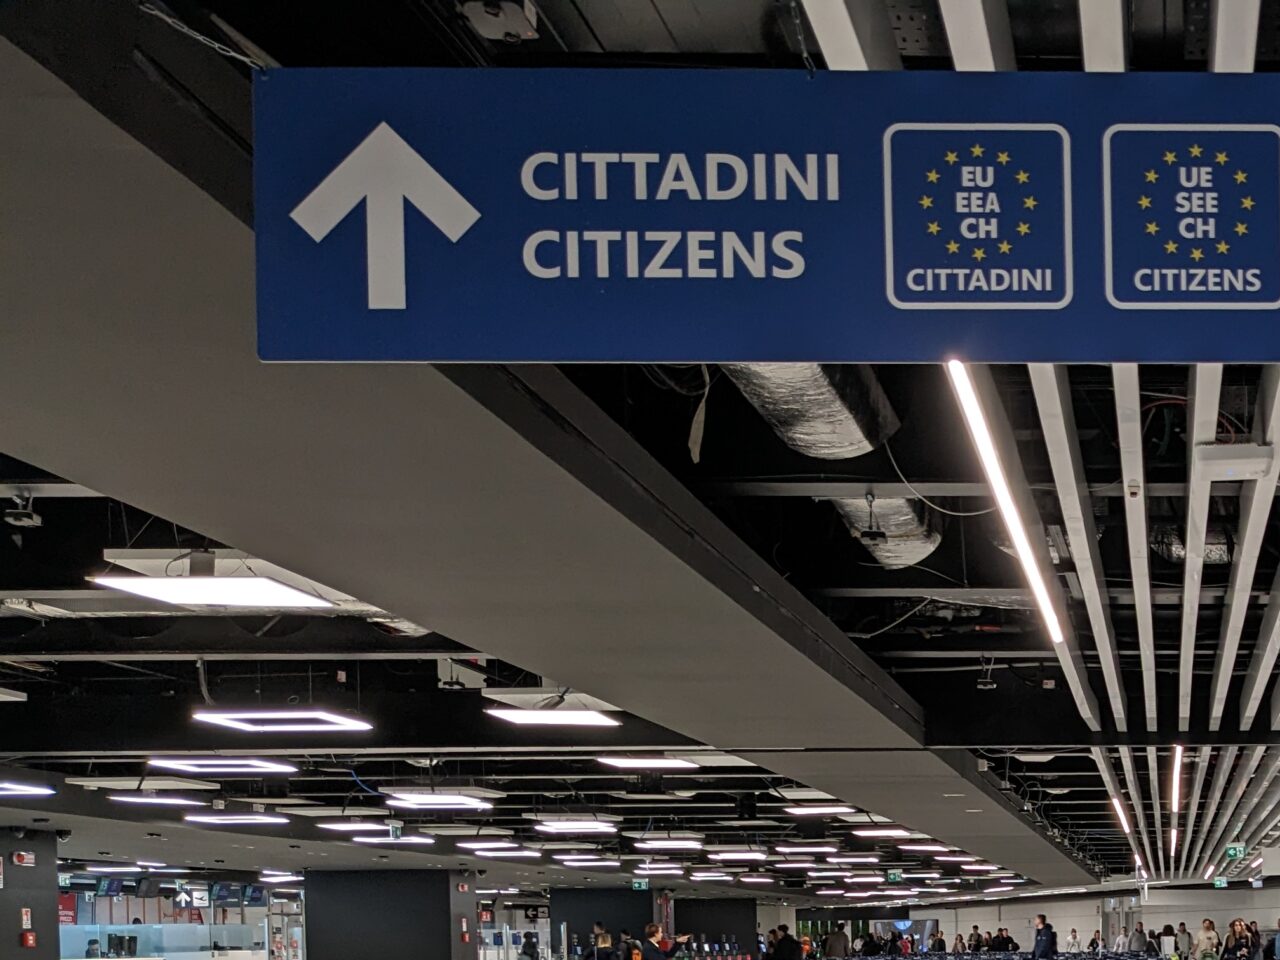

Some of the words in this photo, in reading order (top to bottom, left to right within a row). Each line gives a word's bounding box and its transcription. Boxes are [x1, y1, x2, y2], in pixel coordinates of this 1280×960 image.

[520, 152, 840, 201] CITTADINI
[960, 164, 995, 188] EU
[1179, 164, 1214, 188] UE
[955, 191, 1001, 213] EEA
[1175, 191, 1218, 214] SEE
[960, 217, 998, 239] CH
[1178, 217, 1216, 239] CH
[522, 230, 805, 279] CITIZENS
[906, 268, 1052, 291] CITTADINI
[1134, 268, 1262, 292] CITIZENS
